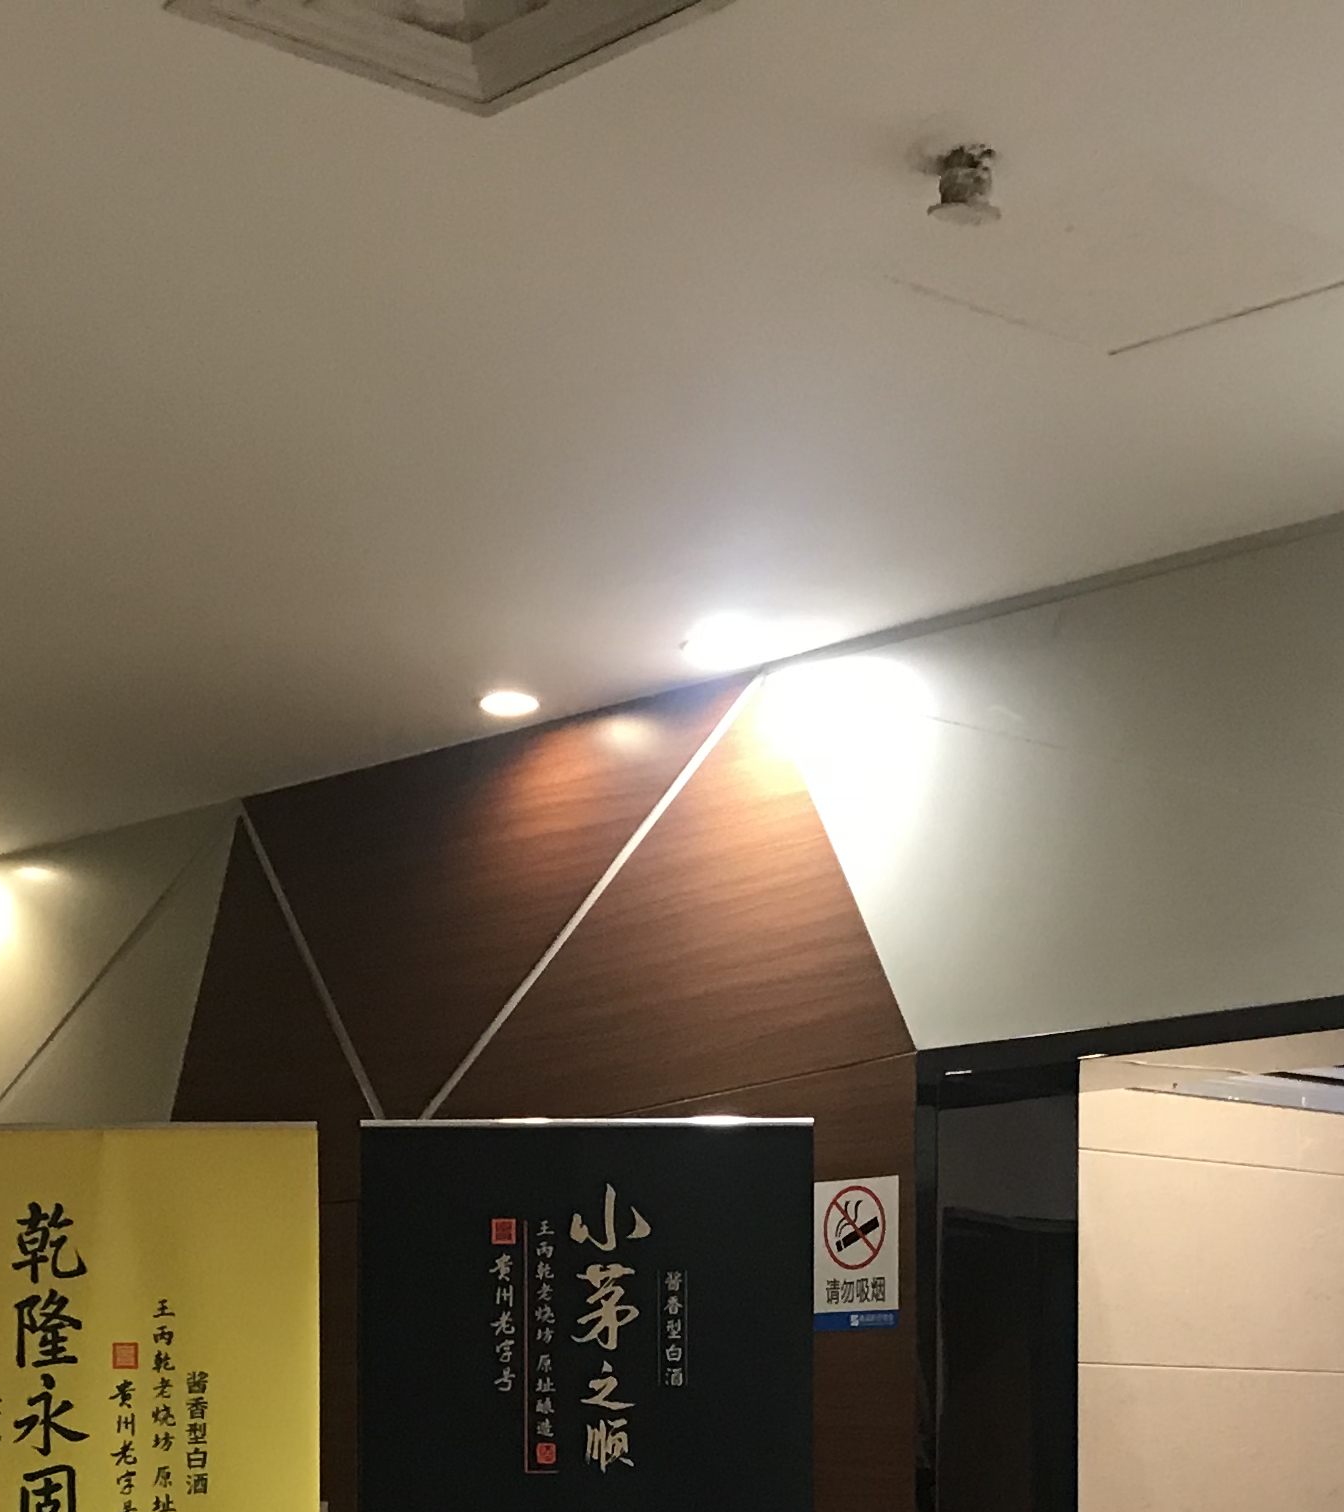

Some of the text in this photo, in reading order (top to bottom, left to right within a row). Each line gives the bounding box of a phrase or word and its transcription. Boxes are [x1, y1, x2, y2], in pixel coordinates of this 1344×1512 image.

[825, 1276, 886, 1305] 请勿吸烟
[184, 1370, 209, 1497] 酱香型白酒
